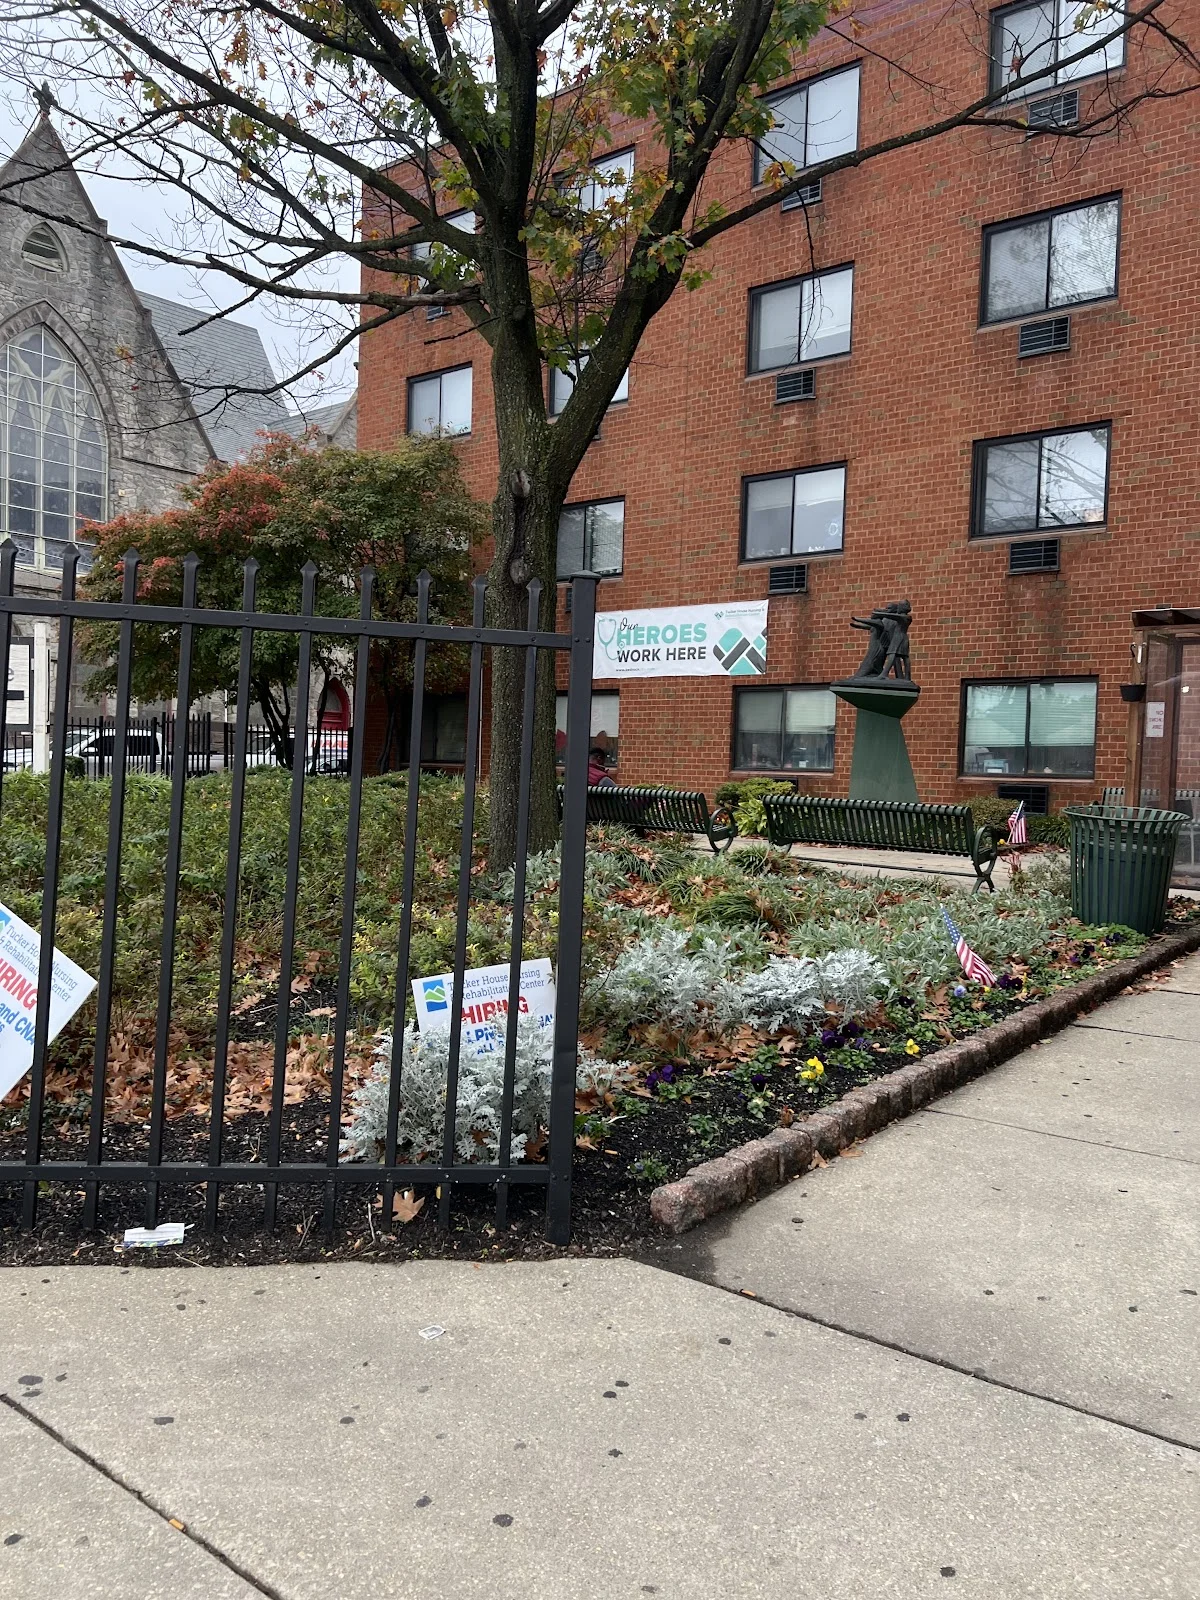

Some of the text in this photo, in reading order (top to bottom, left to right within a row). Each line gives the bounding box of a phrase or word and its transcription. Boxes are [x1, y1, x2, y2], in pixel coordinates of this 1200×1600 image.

[616, 622, 708, 647] HEROES
[619, 617, 639, 632] Our
[616, 646, 707, 663] WORK HERE
[6, 924, 30, 949] Tucker
[0, 957, 38, 1010] IRING
[447, 979, 480, 991] Tker
[481, 974, 508, 986] House
[463, 984, 510, 1000] ehabilitati
[520, 980, 544, 990] Center
